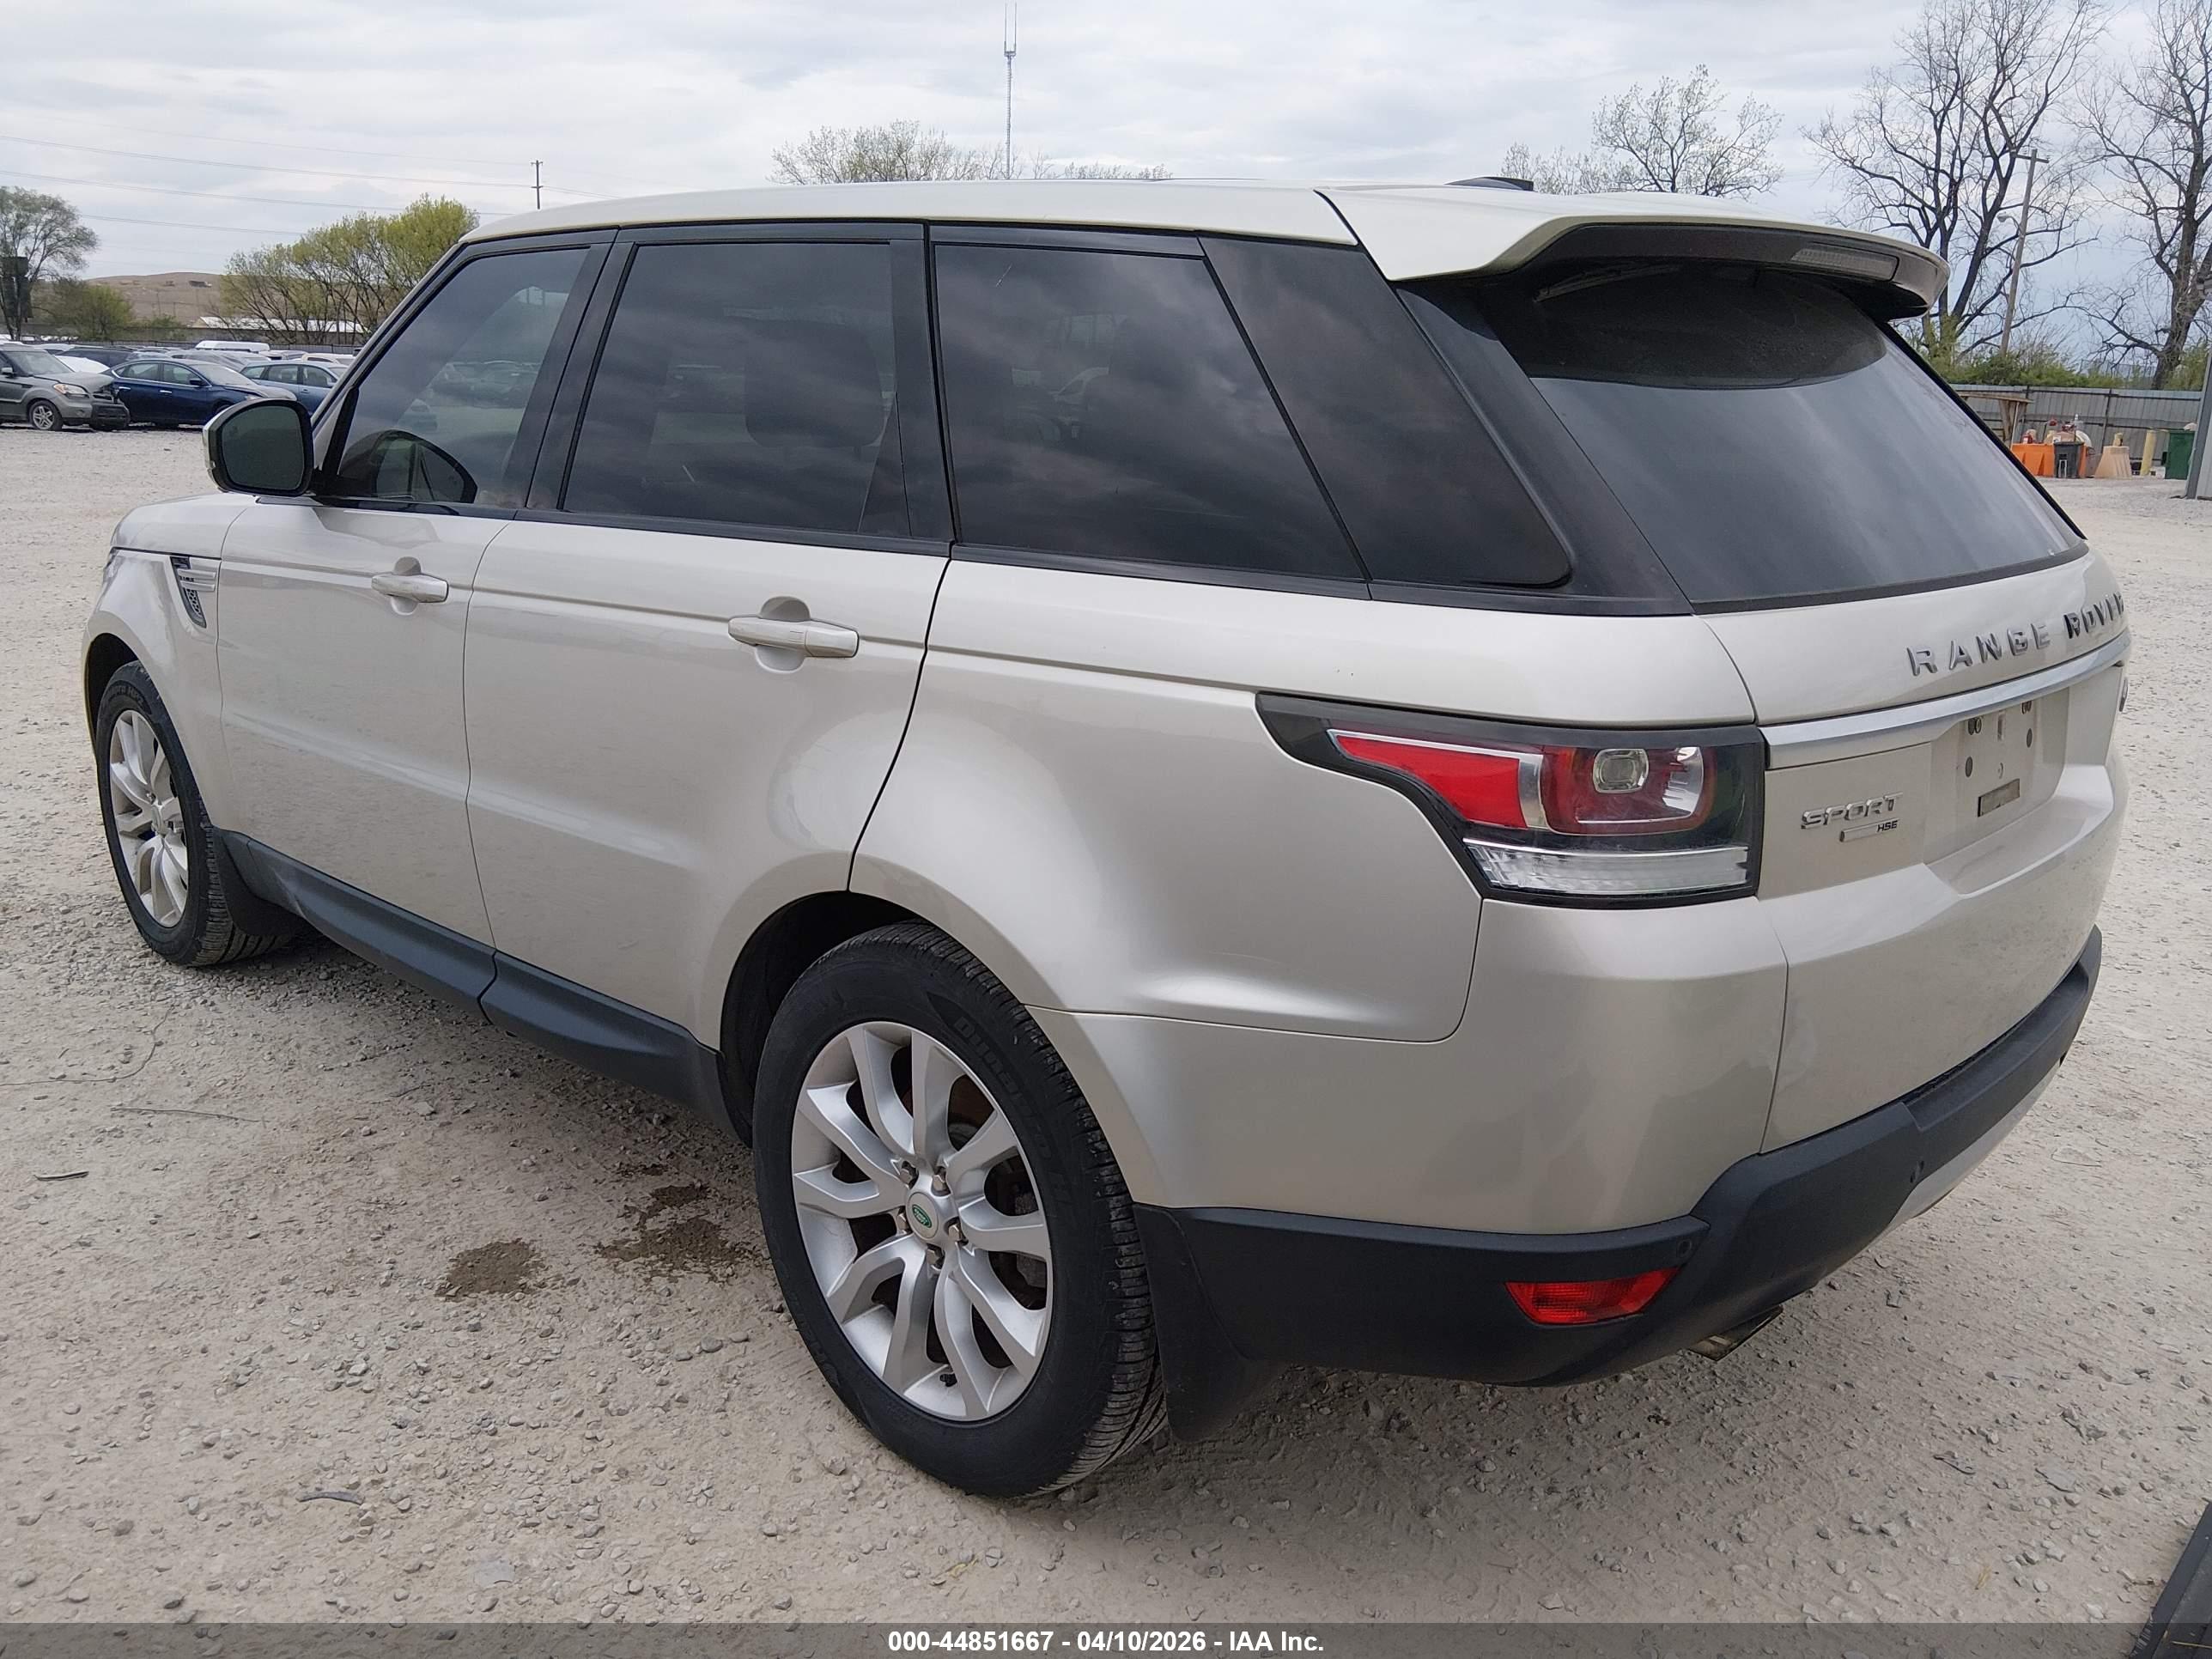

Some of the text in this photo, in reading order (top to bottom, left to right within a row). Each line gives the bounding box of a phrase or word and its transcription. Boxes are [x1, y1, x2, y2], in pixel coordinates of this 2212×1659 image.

[1906, 591, 2125, 677] RANGE ROVER
[1801, 791, 1904, 830] SPORT
[1876, 819, 1899, 833] HSE
